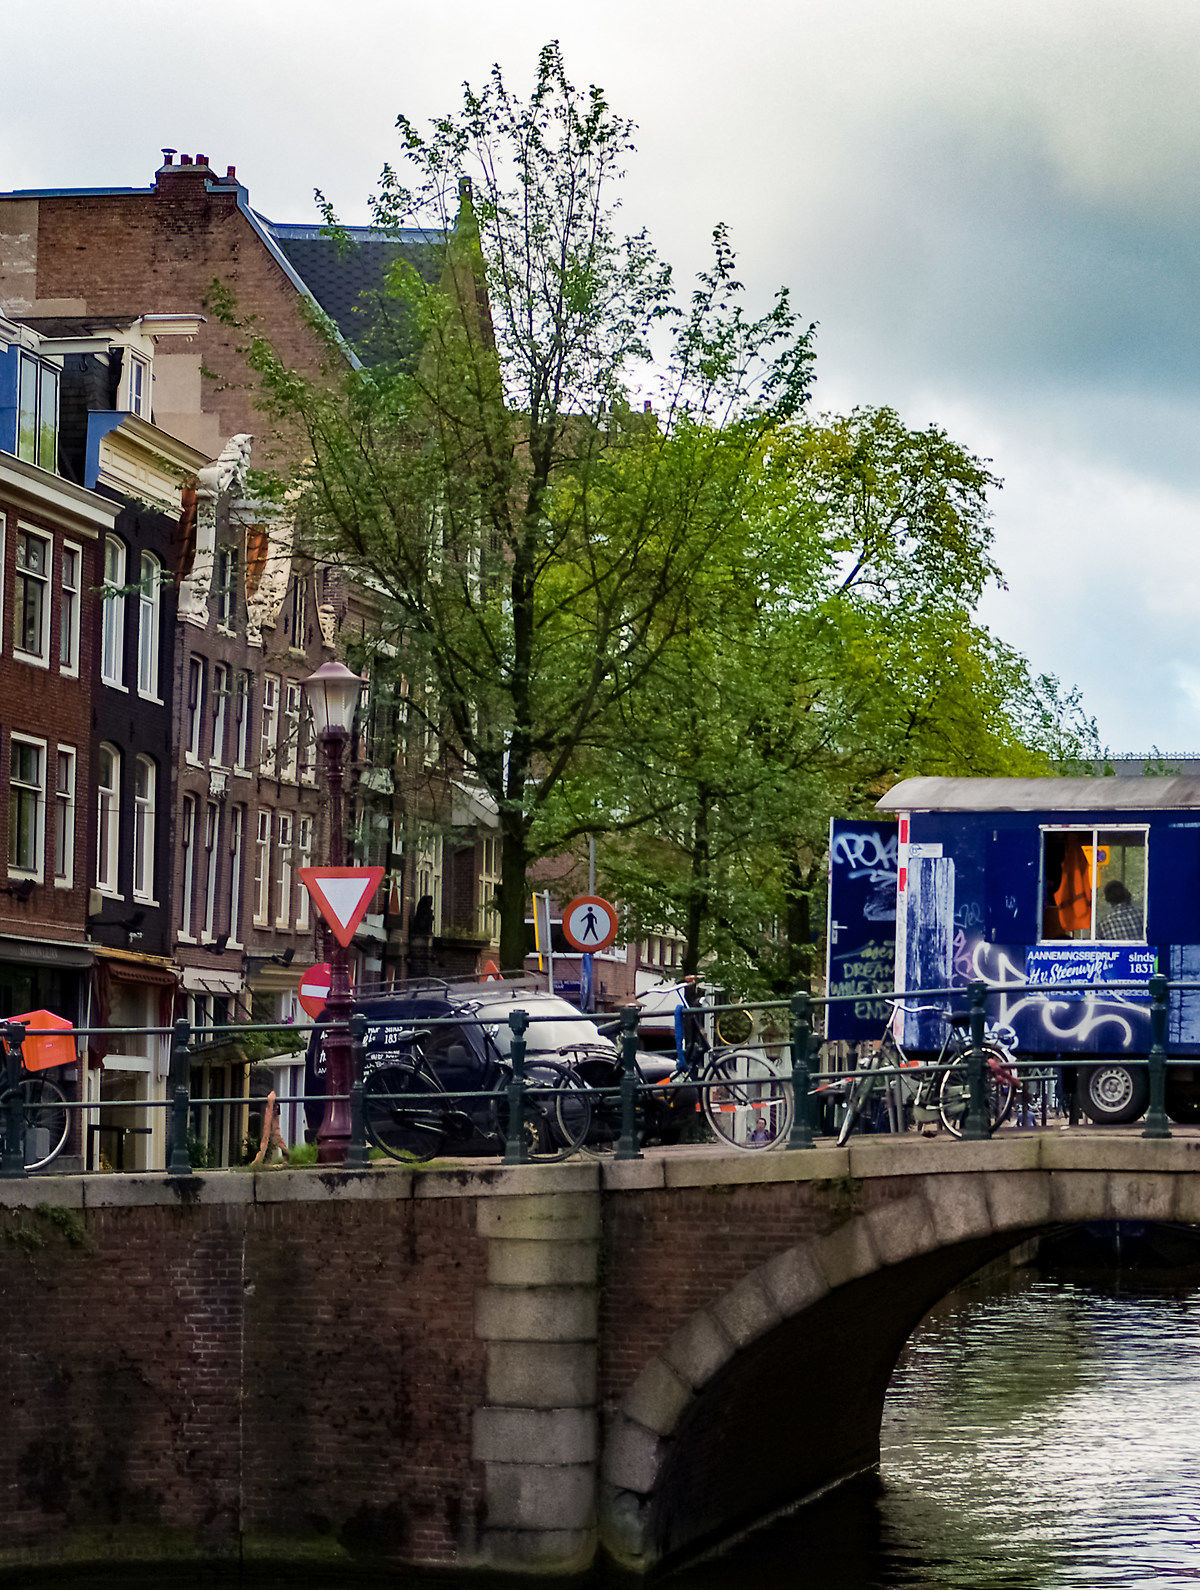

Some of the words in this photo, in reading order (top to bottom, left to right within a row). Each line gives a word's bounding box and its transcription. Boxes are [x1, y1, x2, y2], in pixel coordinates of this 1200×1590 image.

[1027, 951, 1120, 961] AANNEMINGSBEDRIJF
[1128, 952, 1155, 962] sinds
[1129, 963, 1155, 974] 1831
[384, 1033, 398, 1044] 183
